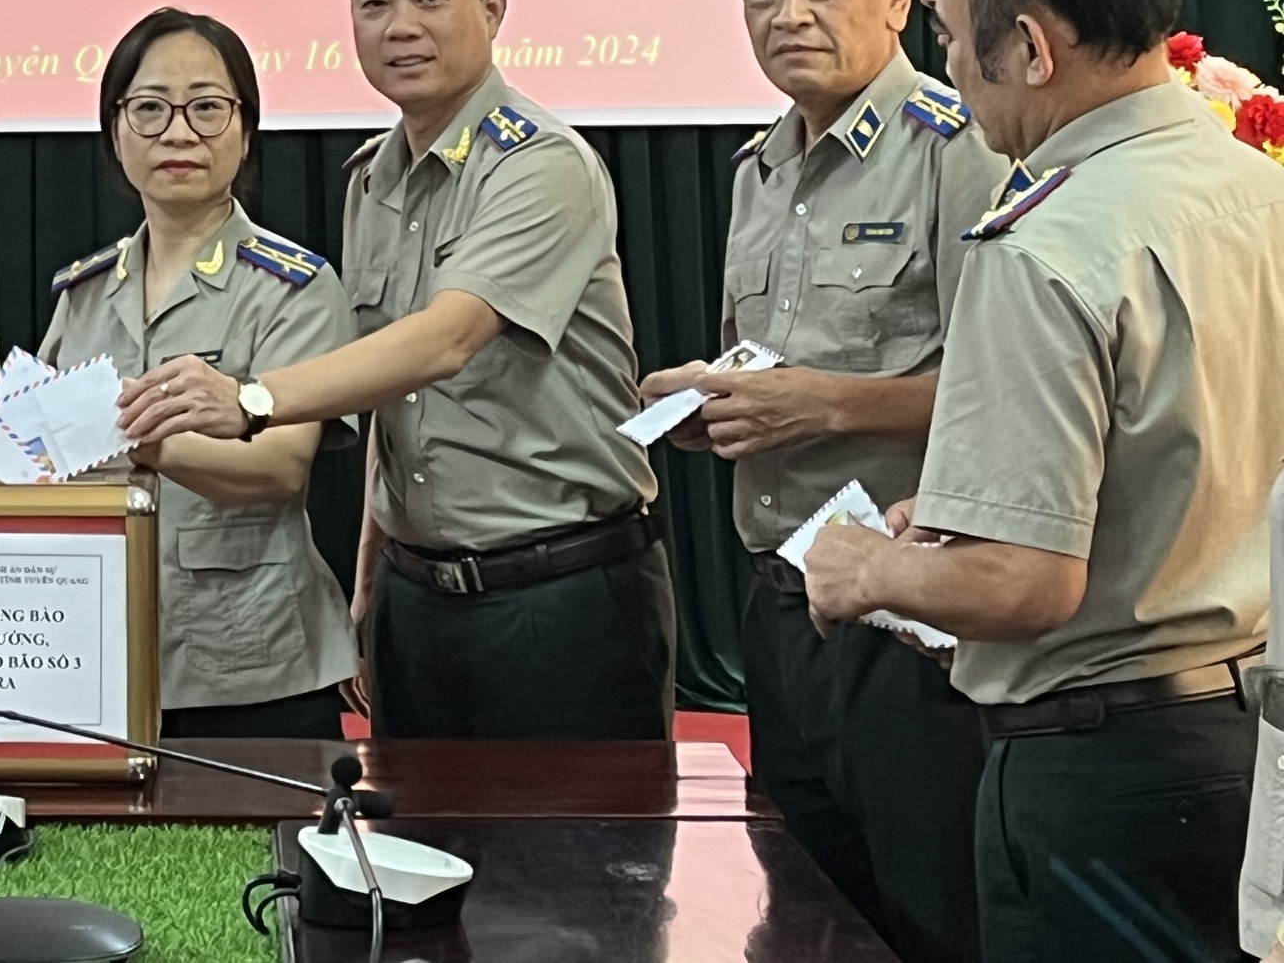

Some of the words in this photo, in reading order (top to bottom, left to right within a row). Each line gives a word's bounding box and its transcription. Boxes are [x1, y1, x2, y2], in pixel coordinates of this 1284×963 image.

[304, 41, 343, 71] 16
[492, 36, 564, 68] năm
[577, 35, 661, 67] 2024
[29, 606, 65, 623] BÀO
[8, 653, 44, 669] BÃO
[73, 656, 82, 669] 3
